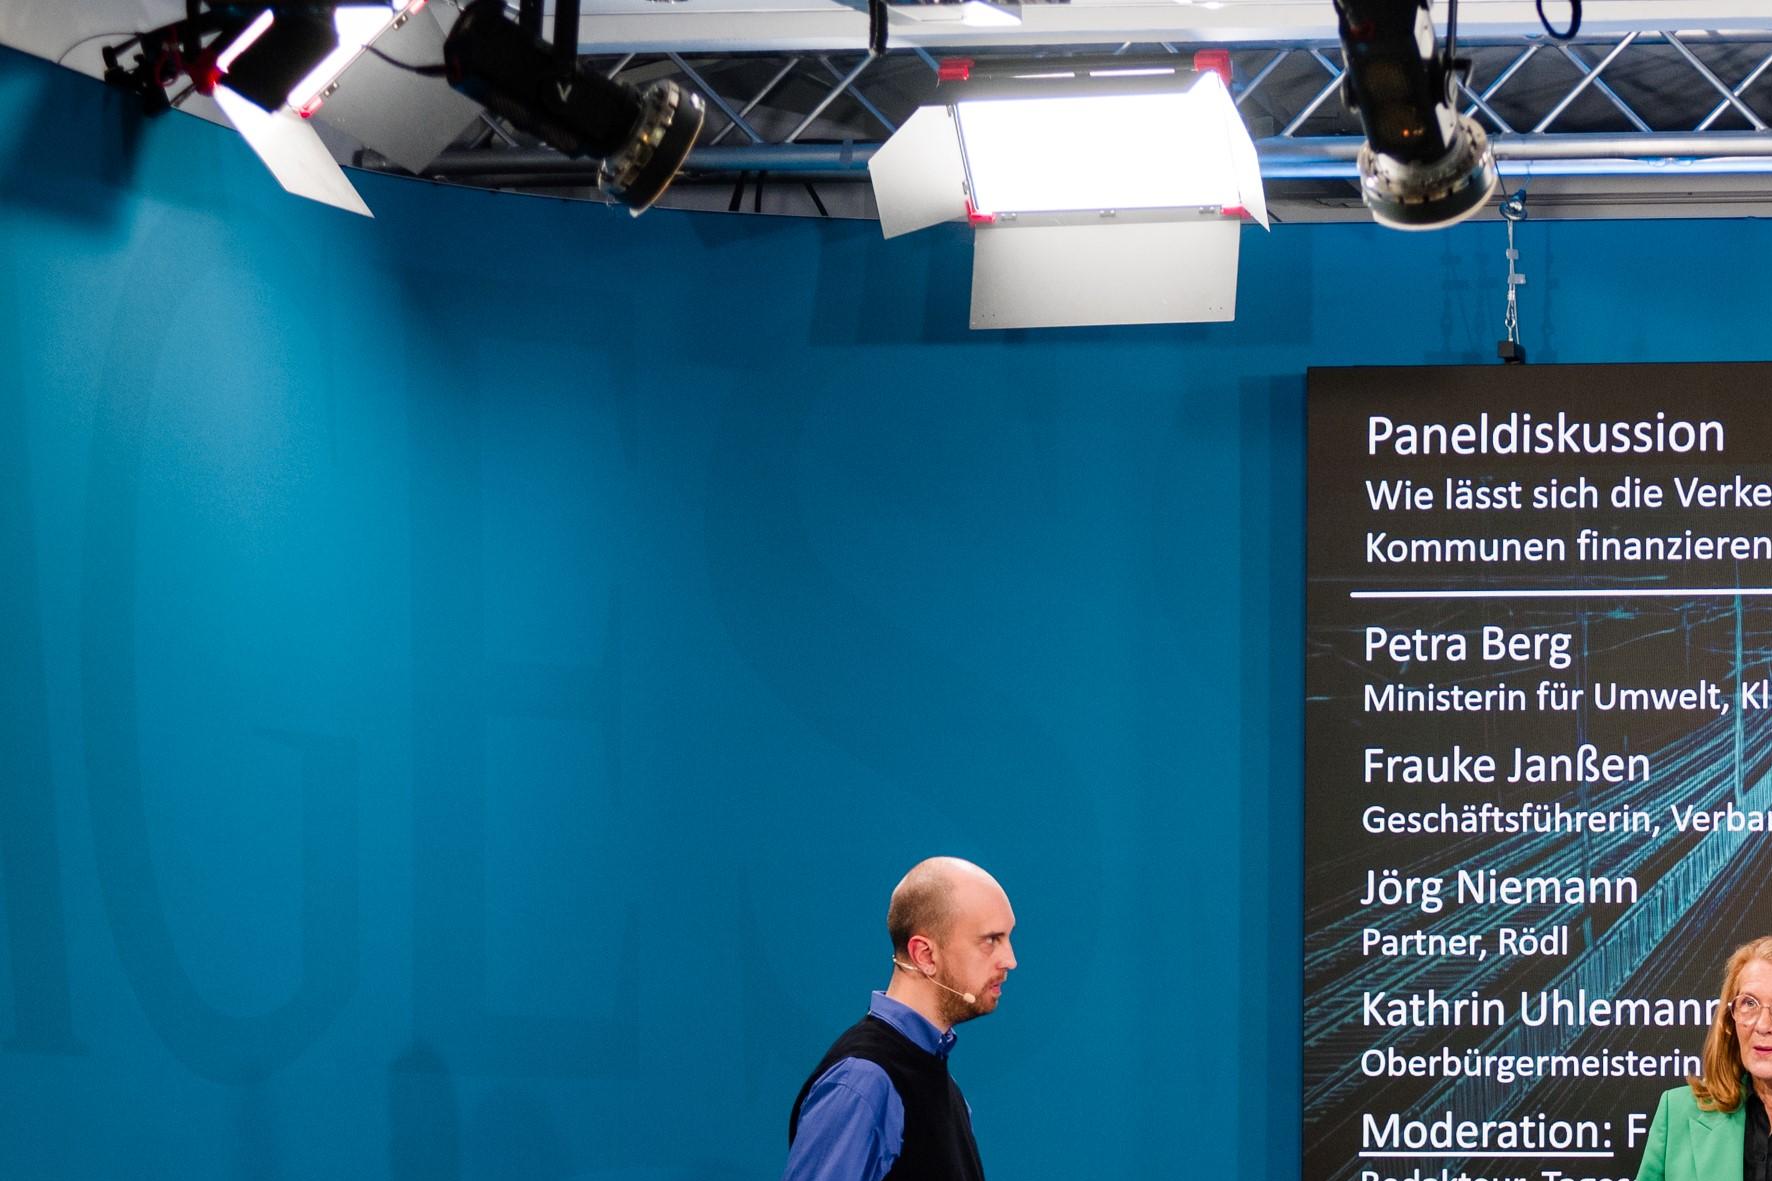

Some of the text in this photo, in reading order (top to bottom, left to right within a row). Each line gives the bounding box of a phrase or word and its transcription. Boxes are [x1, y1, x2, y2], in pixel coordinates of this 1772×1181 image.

[1368, 411, 1724, 455] Paneldiskussion
[1366, 480, 1433, 511] Wie
[1446, 478, 1522, 510] lässt
[1532, 477, 1598, 509] sich
[1610, 476, 1663, 508] die
[1366, 532, 1565, 563] Kommunen
[1365, 627, 1572, 670] Petra Berg
[1364, 683, 1526, 712] Ministerin
[1536, 681, 1584, 711] für
[1594, 680, 1729, 716] Umwelt,
[1365, 744, 1650, 783] Frauke Janßen
[1363, 803, 1660, 838] Geschäftsführerin,
[1361, 869, 1637, 914] Jörg Niemann
[1363, 926, 1568, 962] Partner, Rödl
[1363, 989, 1505, 1027] Kathrin
[1361, 1047, 1701, 1083] Oberbürgermeisterin
[1362, 1110, 1611, 1150] Moderation:
